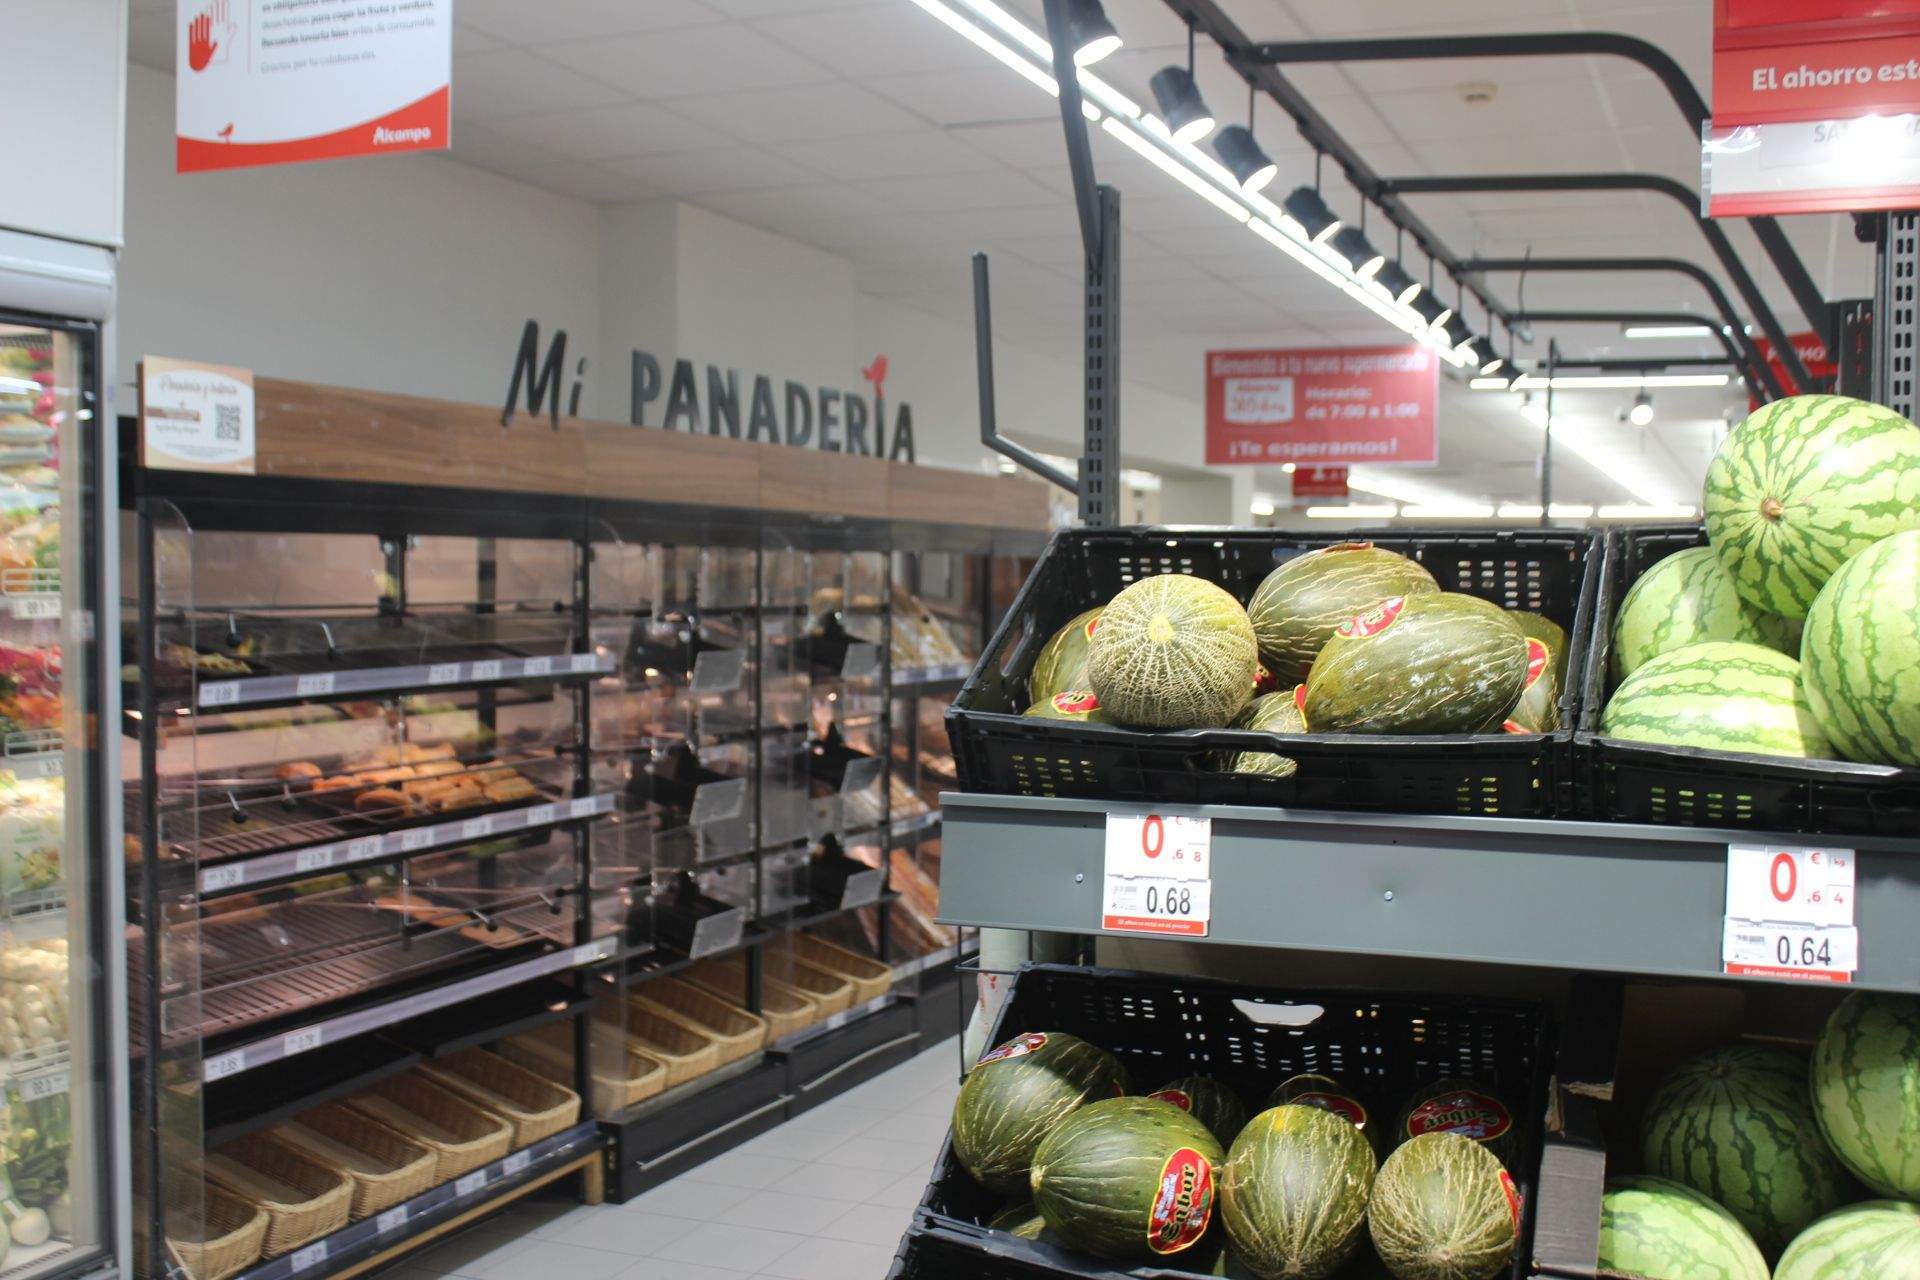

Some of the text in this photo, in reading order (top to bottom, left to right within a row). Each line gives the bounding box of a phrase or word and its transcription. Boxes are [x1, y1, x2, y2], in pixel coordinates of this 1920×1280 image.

[1752, 59, 1920, 91] El ahorro est
[373, 126, 432, 146] Alcampo
[501, 318, 588, 431] Mi
[1267, 436, 1398, 459] esperamos!
[1146, 885, 1191, 915] 0.68
[1777, 935, 1832, 967] 0.64
